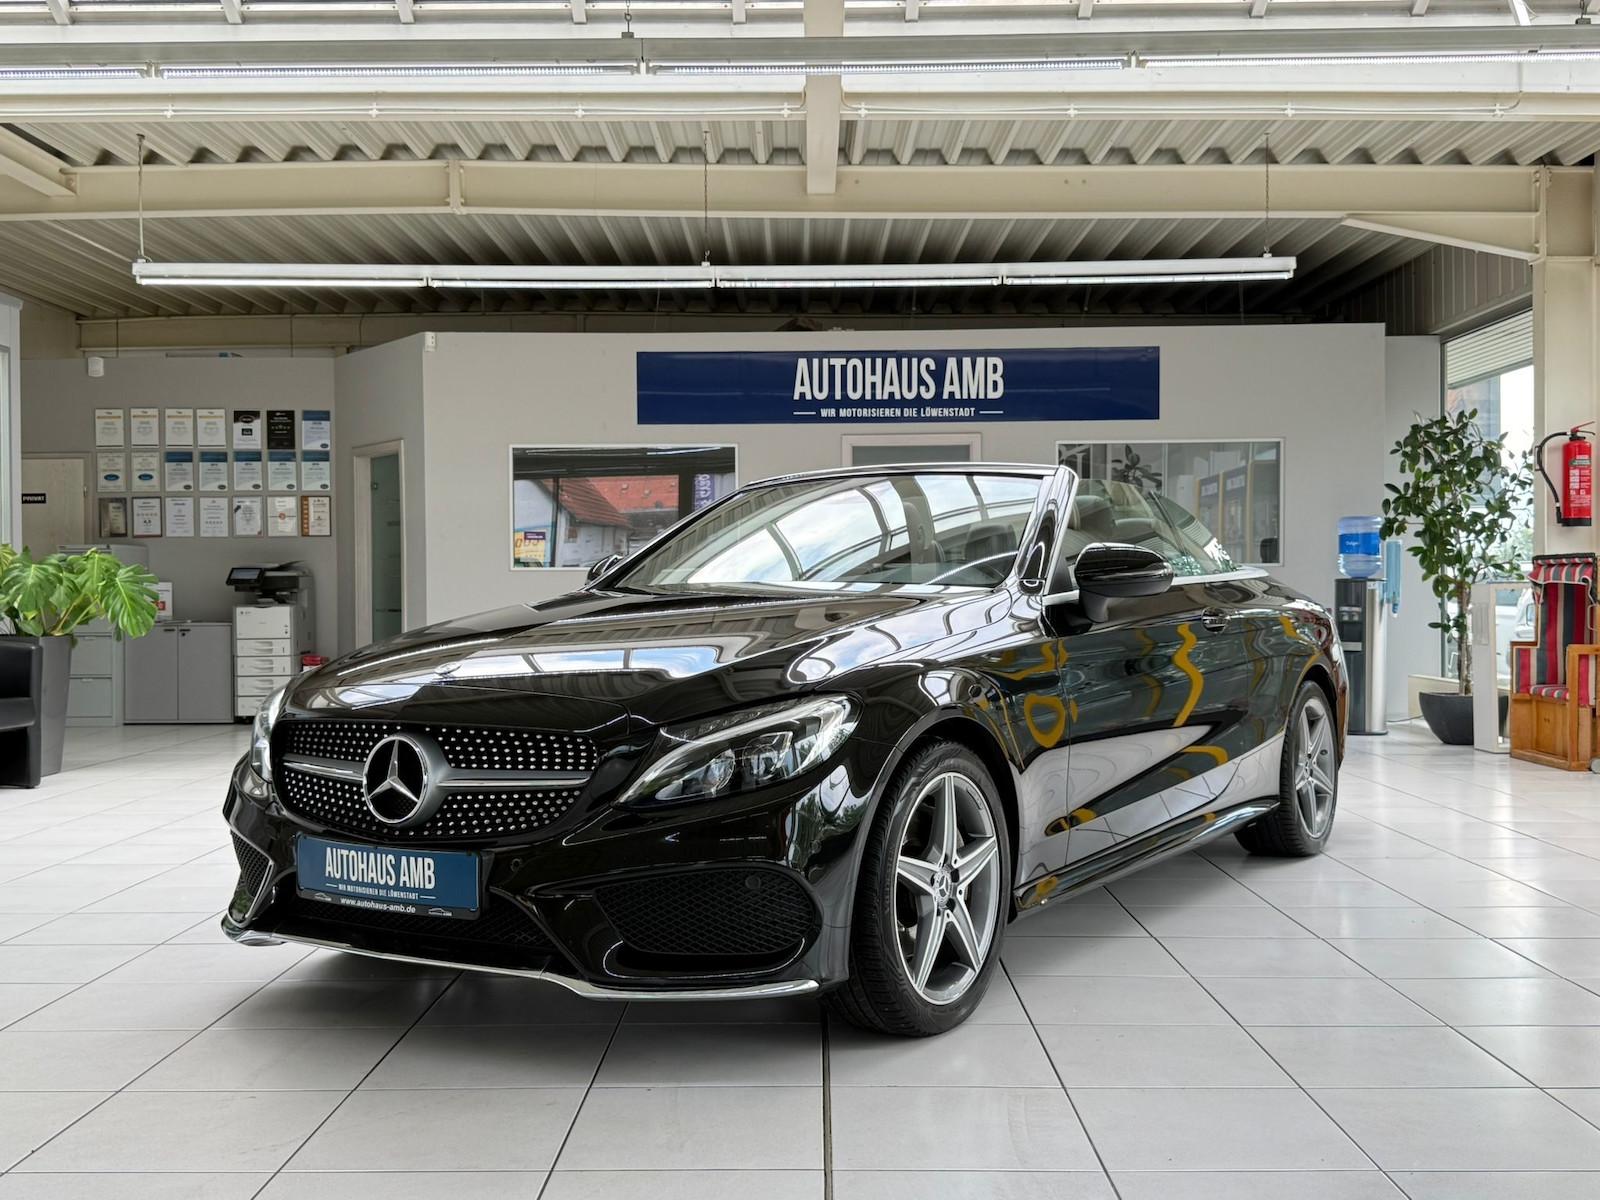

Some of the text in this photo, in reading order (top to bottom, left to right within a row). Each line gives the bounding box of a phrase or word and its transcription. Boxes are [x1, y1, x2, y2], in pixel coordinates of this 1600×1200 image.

[793, 357, 1004, 400] AUTOHAUS AMB
[820, 406, 976, 418] WIR MOTORISIEREN DIE LÖWENSTADT
[325, 847, 436, 890] AUTOHAUS AMB
[340, 898, 416, 914] www.autohaus-amb.de
